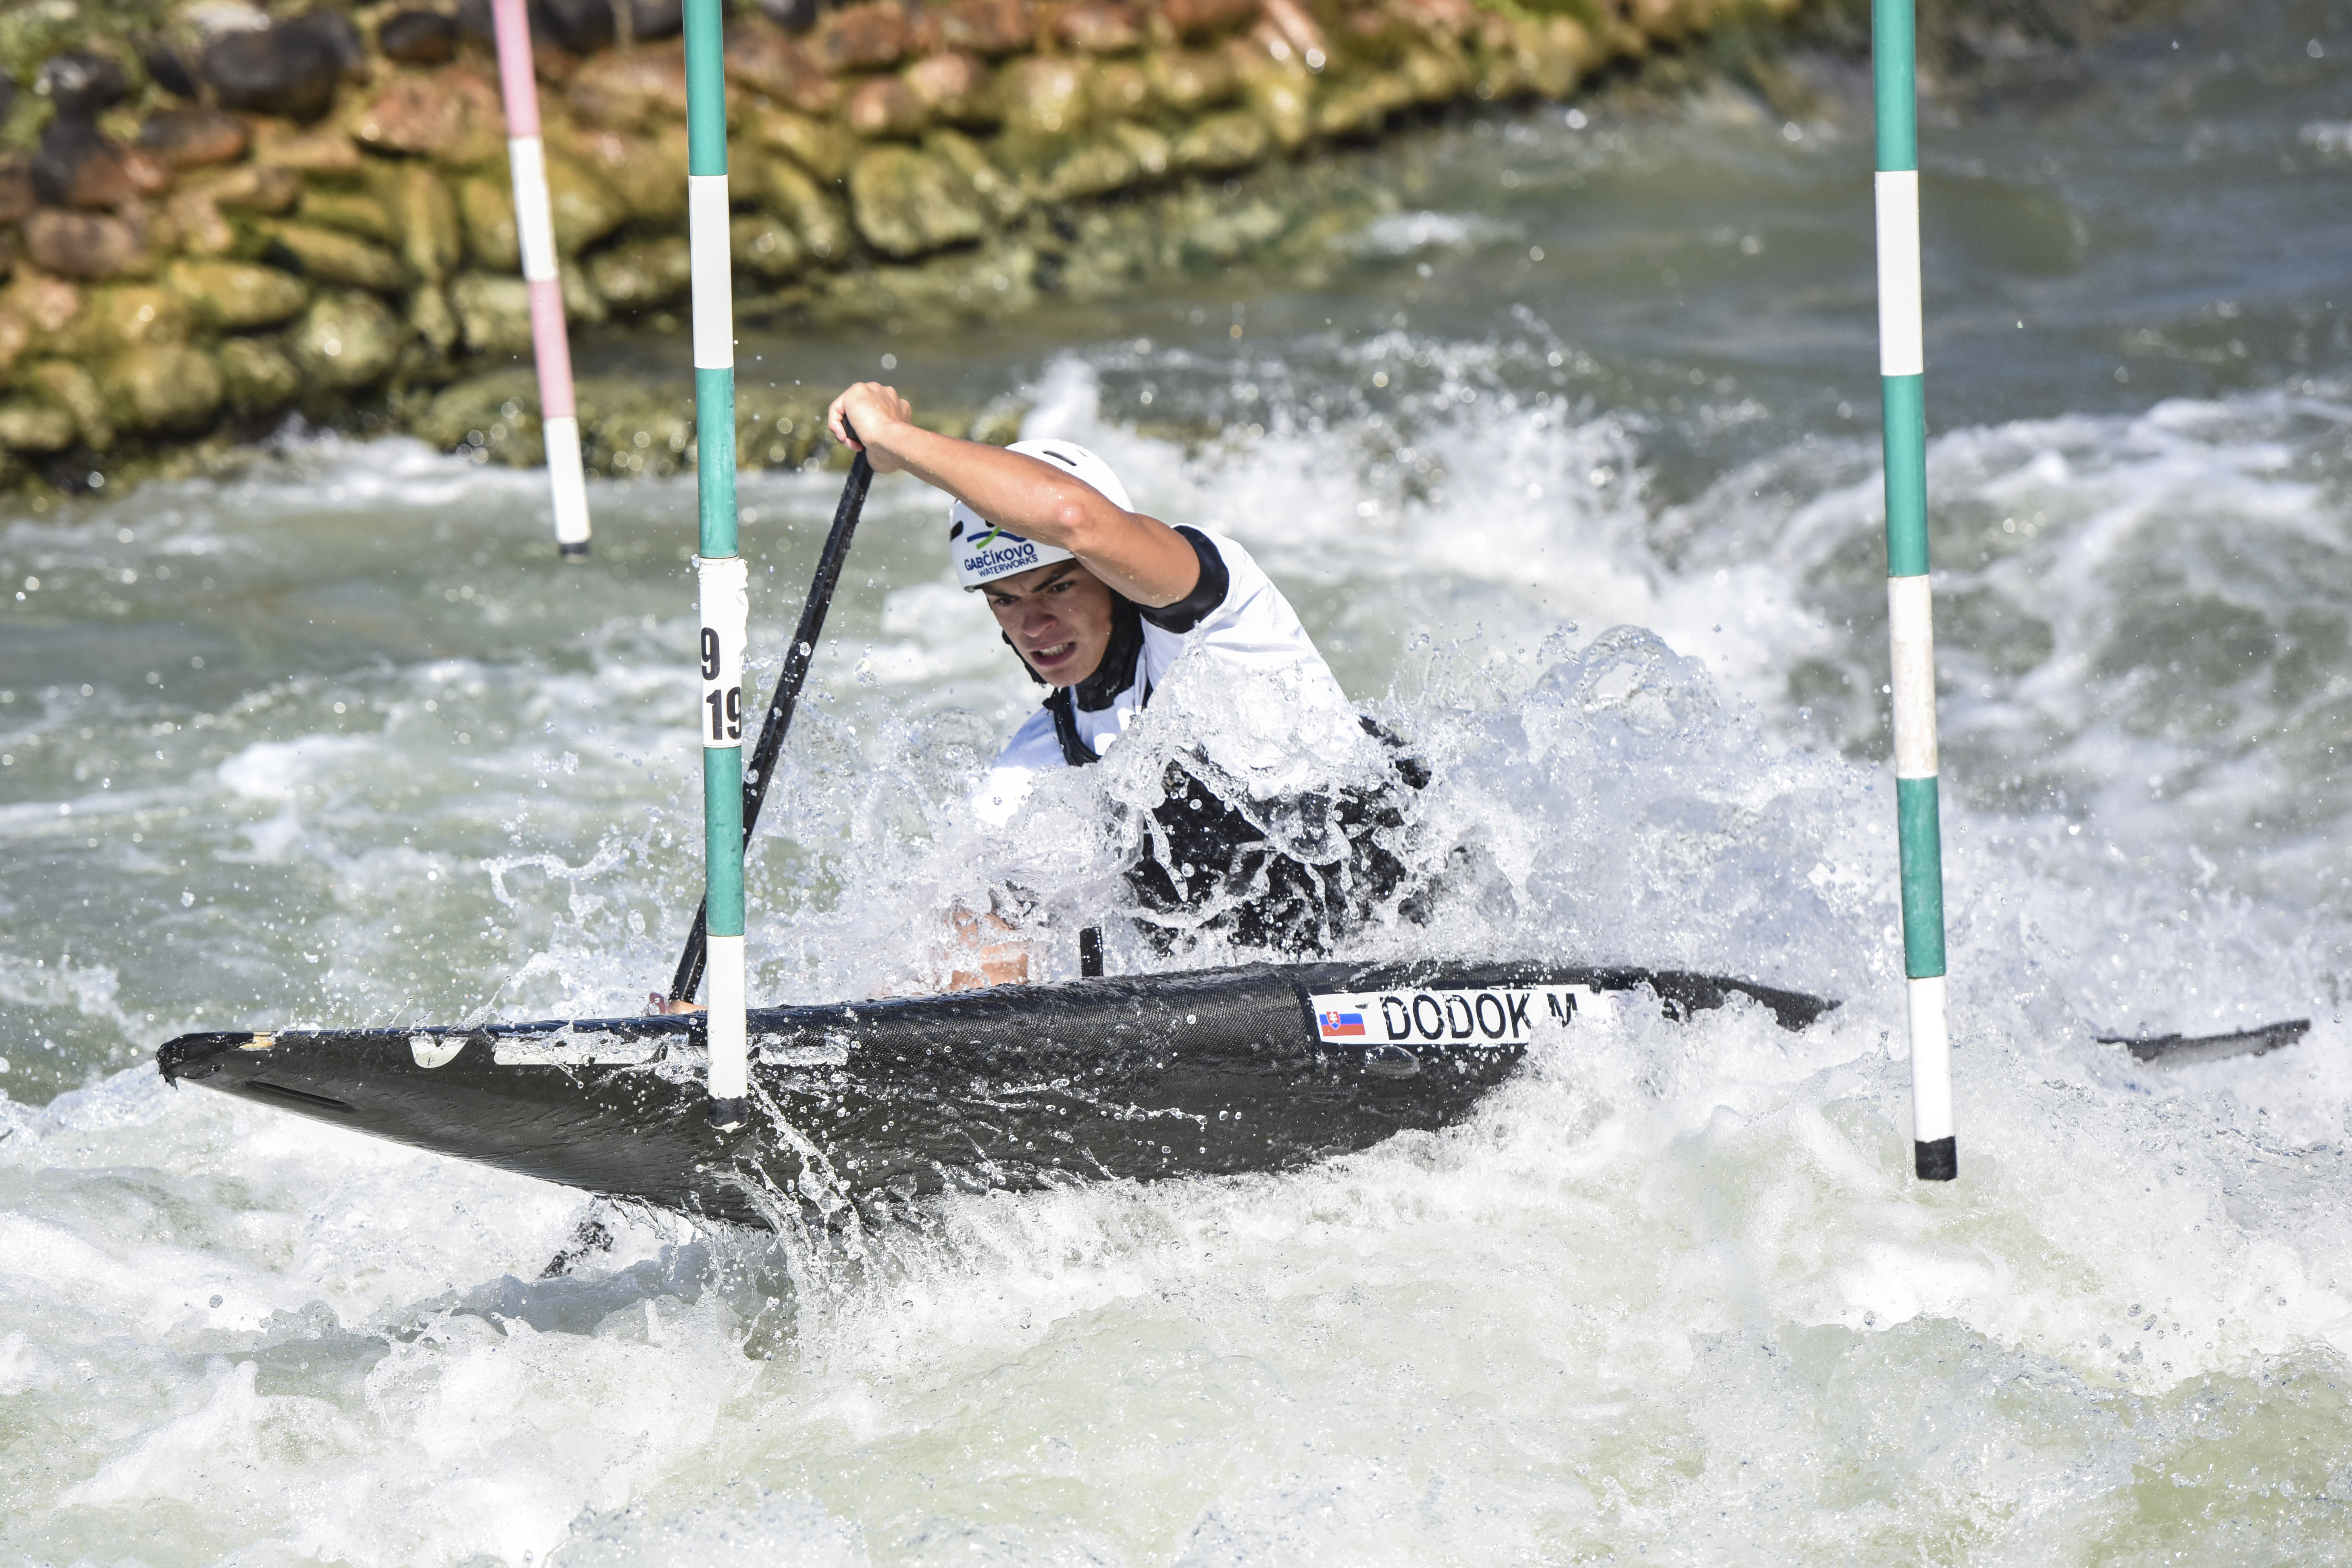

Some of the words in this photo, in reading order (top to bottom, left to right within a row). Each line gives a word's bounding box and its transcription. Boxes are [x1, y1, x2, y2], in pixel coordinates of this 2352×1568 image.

[965, 543, 1034, 571] GABČÍKOVO
[978, 554, 1038, 577] WATERWORKS
[701, 627, 720, 681] 9
[706, 686, 741, 740] 19
[1379, 993, 1532, 1040] DODOK
